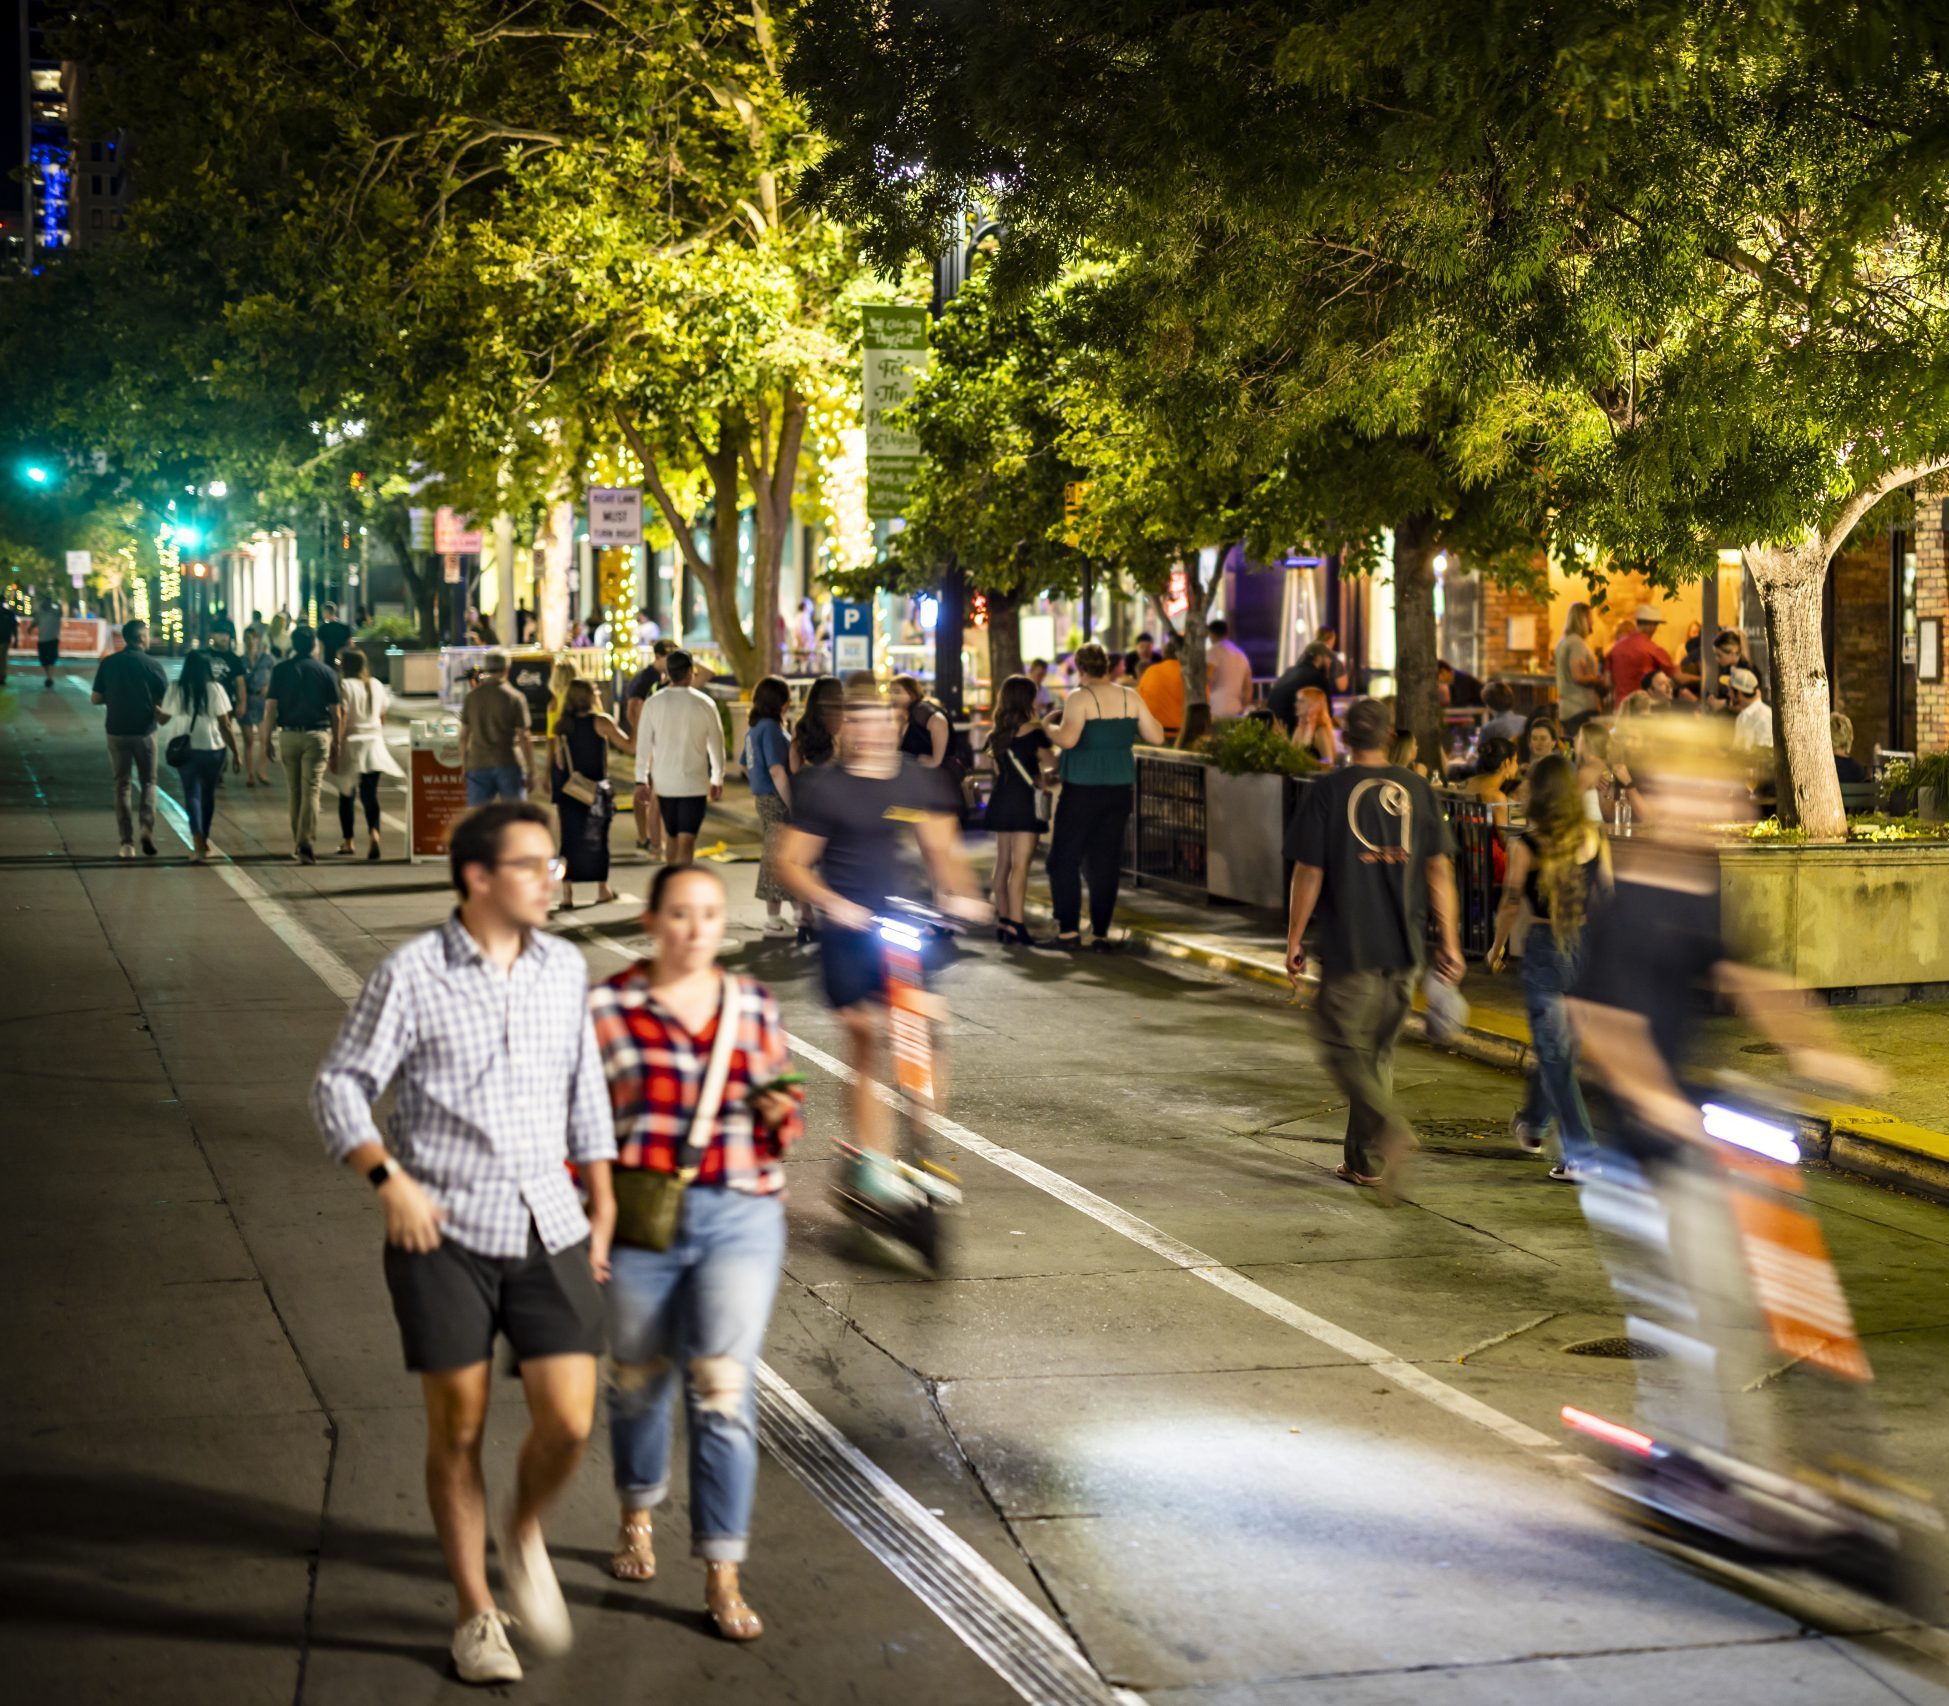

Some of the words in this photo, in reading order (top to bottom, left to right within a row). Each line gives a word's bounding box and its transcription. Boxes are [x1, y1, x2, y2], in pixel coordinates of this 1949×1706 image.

[878, 356, 910, 379] For
[874, 382, 908, 403] The
[617, 494, 636, 504] LANE
[602, 511, 628, 523] MUST
[615, 528, 637, 538] RIGHT
[844, 608, 860, 631] P
